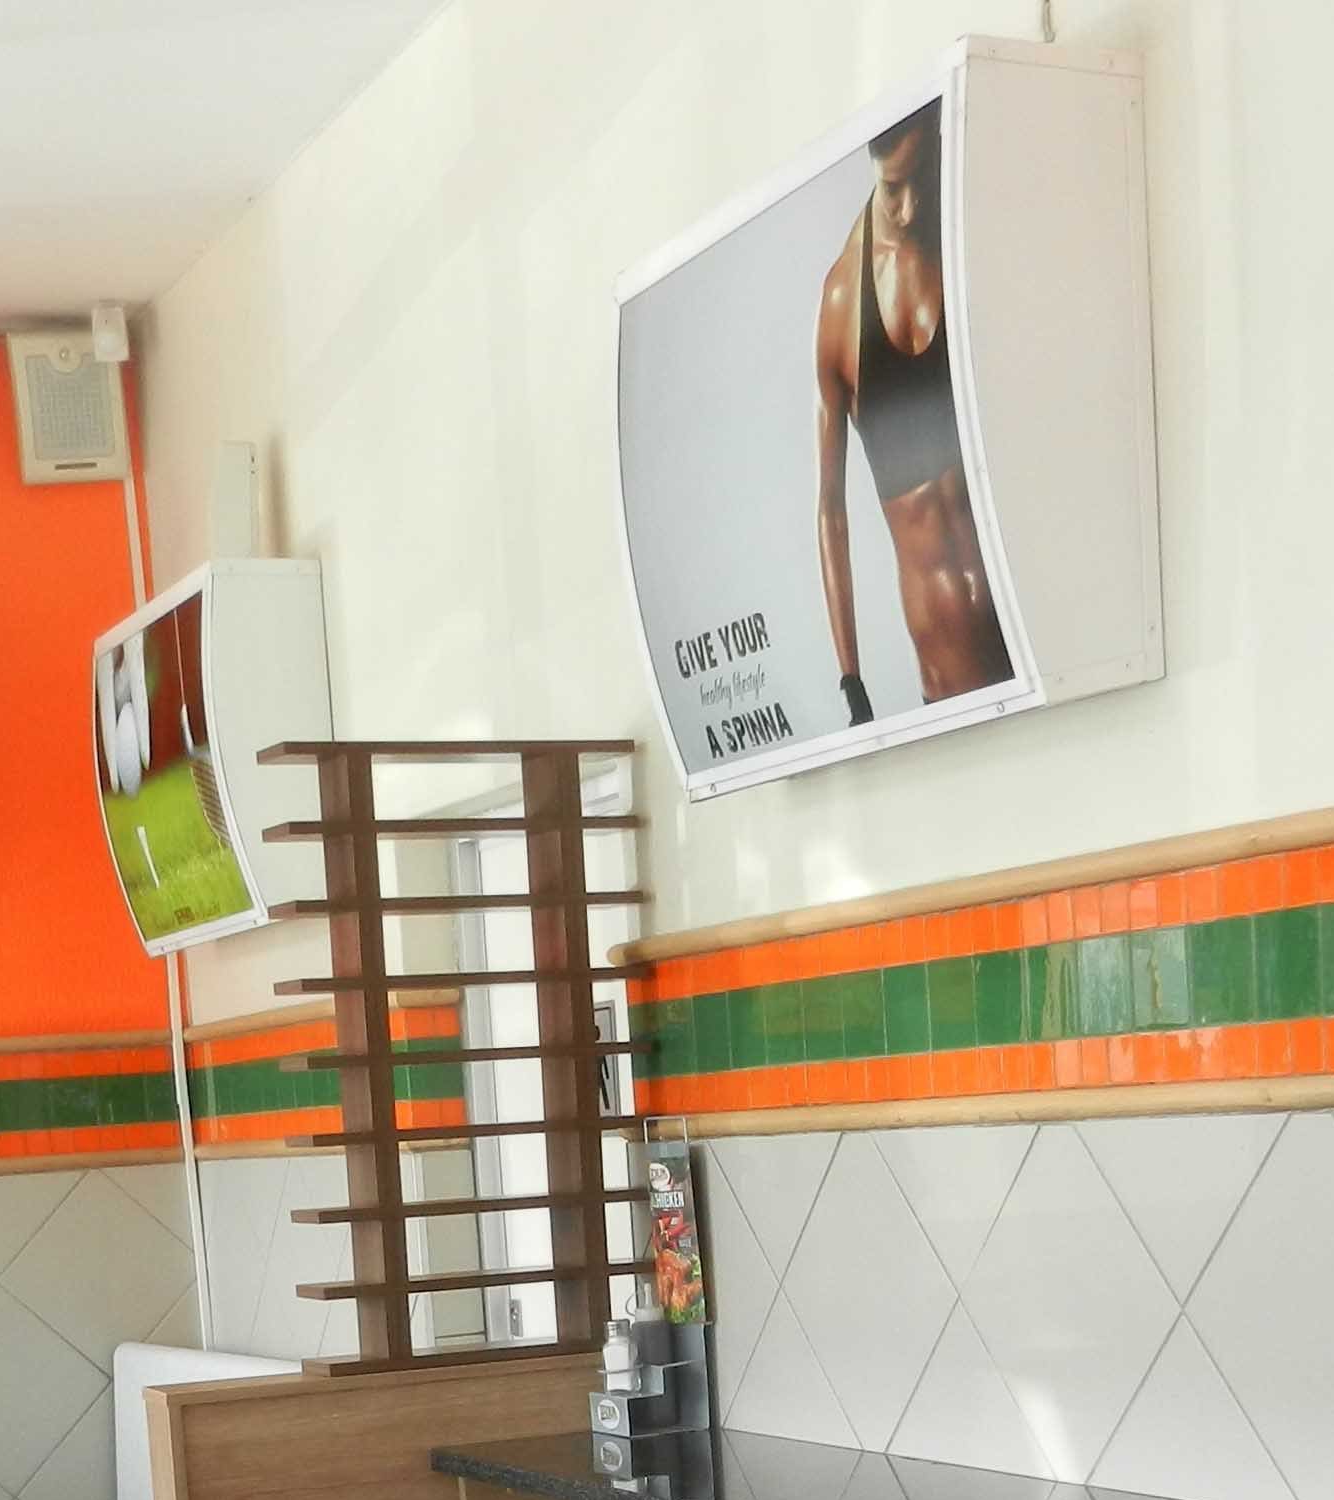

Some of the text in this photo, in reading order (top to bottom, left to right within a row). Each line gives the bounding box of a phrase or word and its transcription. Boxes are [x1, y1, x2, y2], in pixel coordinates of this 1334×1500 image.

[675, 613, 770, 679] GIVE YOUR
[706, 703, 794, 759] A SPINNA
